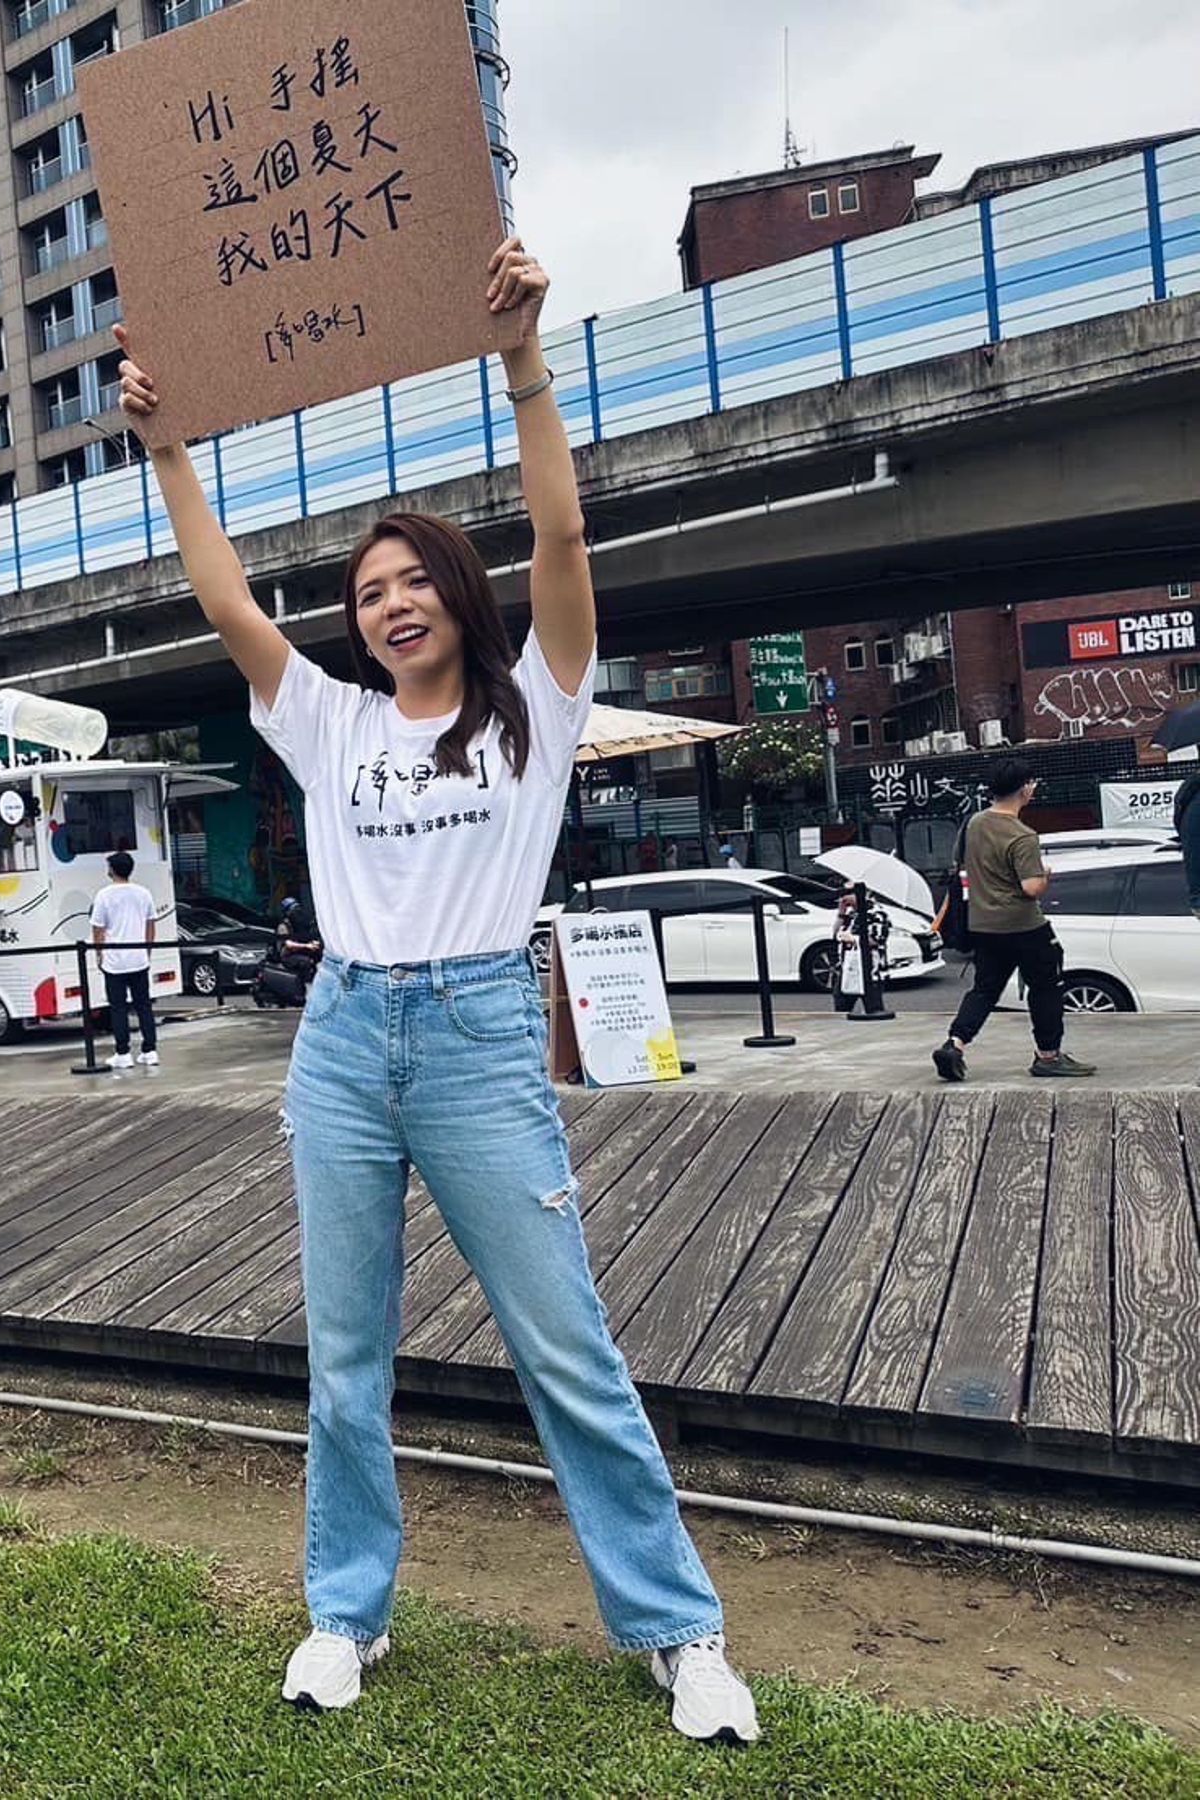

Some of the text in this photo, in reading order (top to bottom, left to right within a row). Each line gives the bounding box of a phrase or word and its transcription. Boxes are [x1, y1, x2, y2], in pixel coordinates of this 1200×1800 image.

[189, 35, 360, 143] Hi 手搖
[203, 102, 399, 212] 這個夏天
[216, 170, 413, 286] 我的天下
[1118, 610, 1194, 633] DARE TO
[1077, 630, 1110, 649] JBL
[1119, 626, 1196, 654] LISTEN
[1128, 790, 1174, 808] 2025
